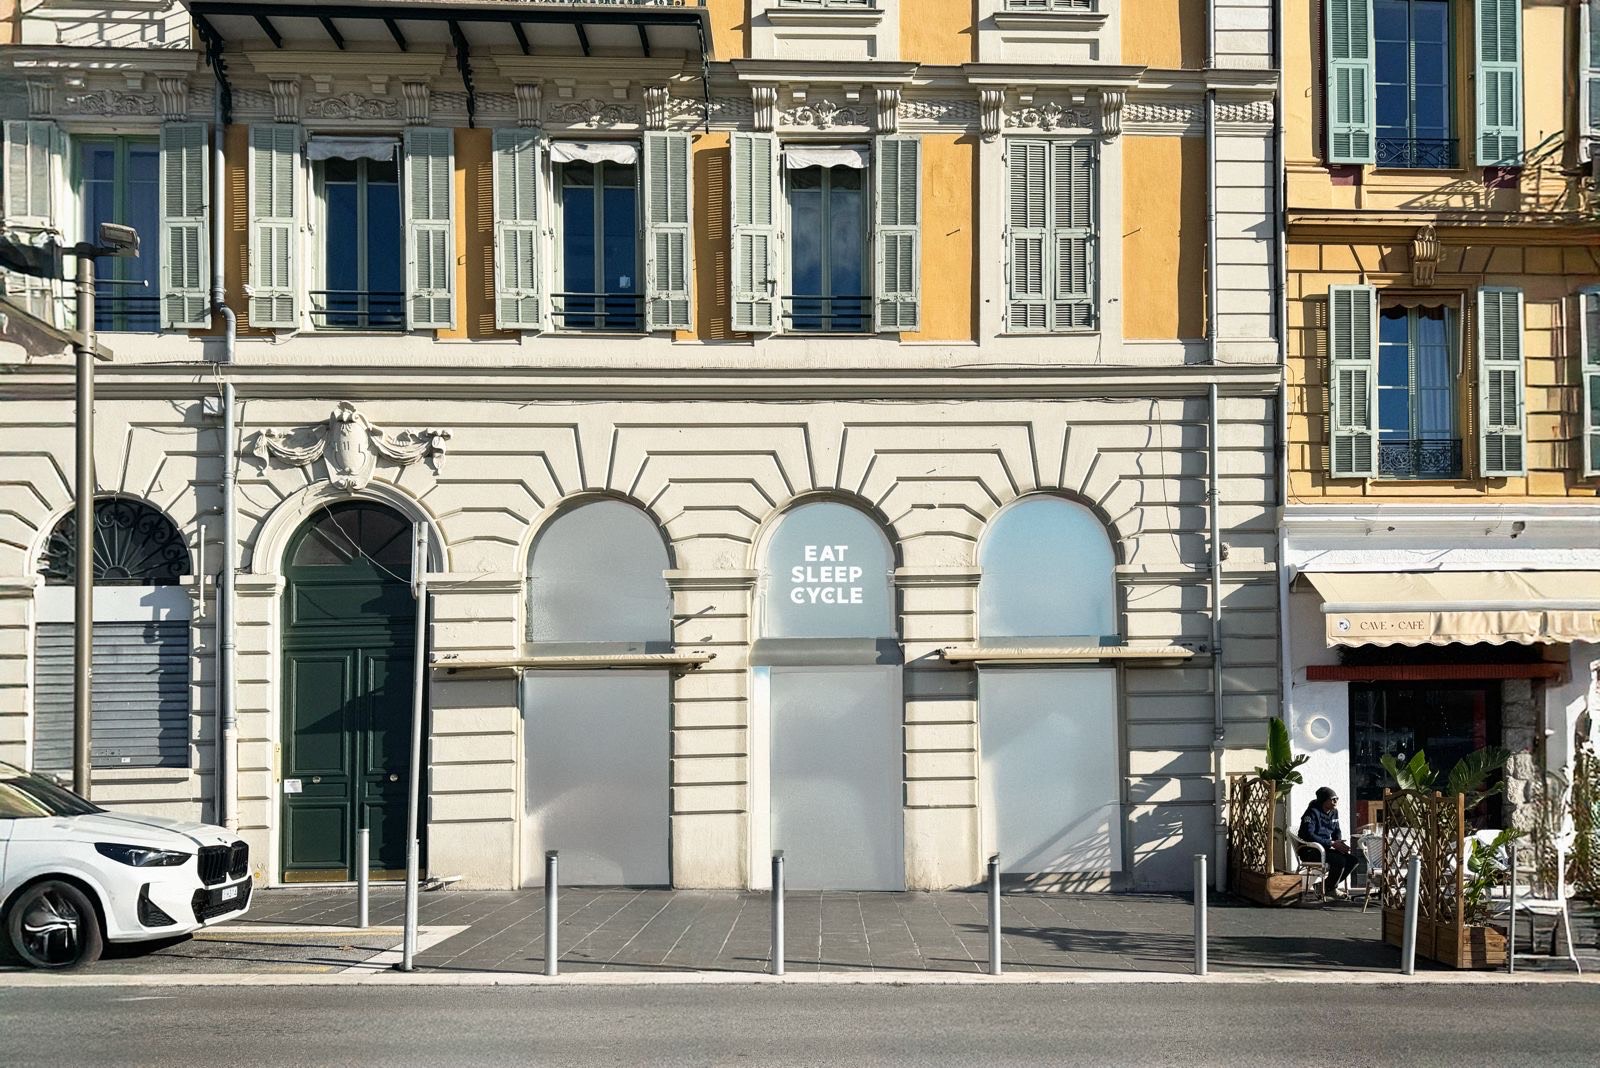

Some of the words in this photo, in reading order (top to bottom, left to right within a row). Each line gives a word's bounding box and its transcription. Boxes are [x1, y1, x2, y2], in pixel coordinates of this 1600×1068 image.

[804, 545, 848, 562] EAT
[791, 566, 863, 583] SLEEP
[790, 587, 864, 604] CYCLE
[1360, 621, 1387, 631] CAVE
[1398, 619, 1425, 631] CAFÉ
